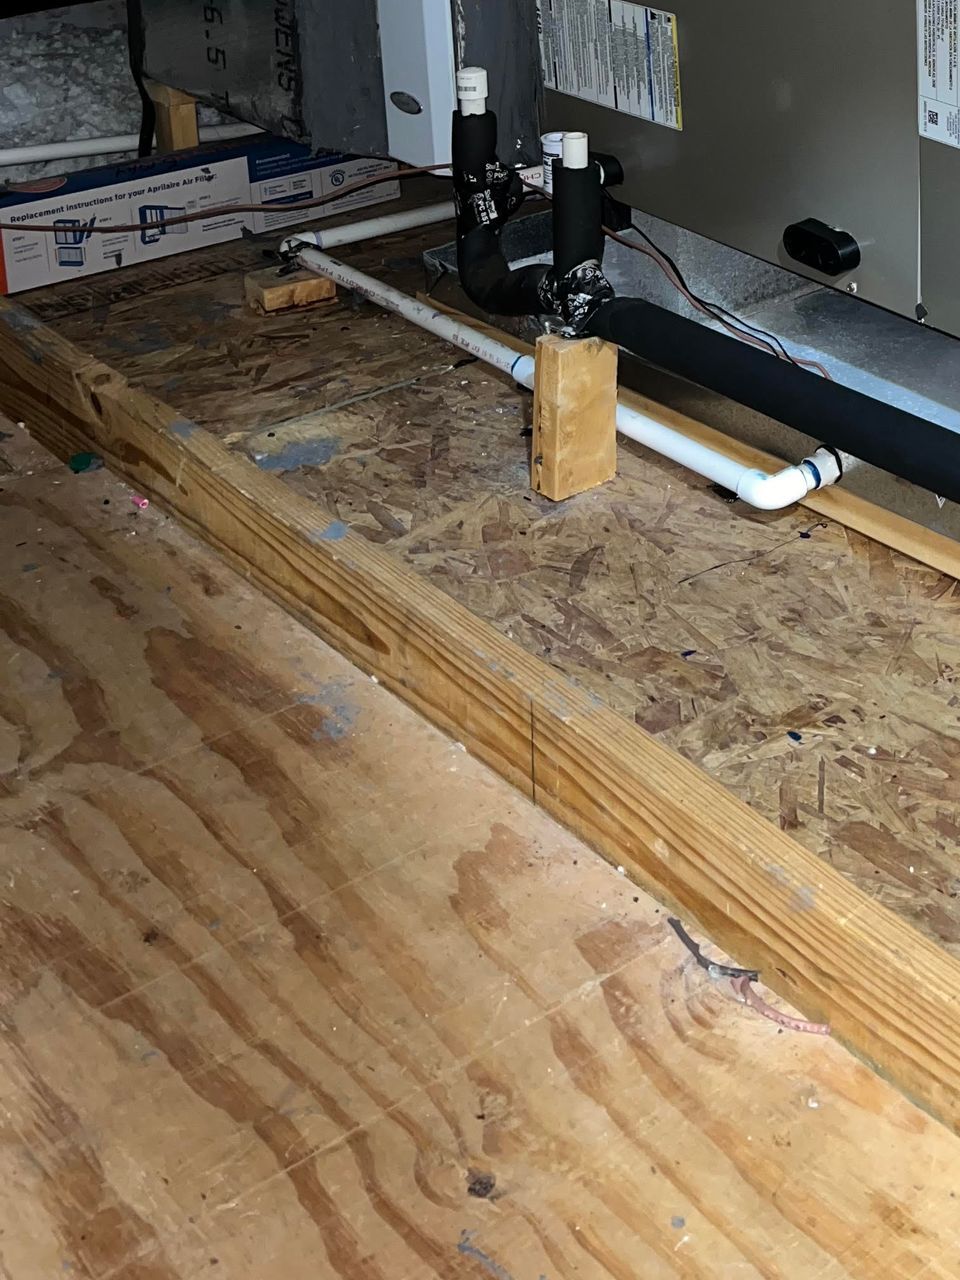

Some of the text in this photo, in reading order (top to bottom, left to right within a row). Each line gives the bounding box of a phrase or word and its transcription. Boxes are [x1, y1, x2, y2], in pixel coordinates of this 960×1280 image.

[10, 206, 65, 224] Replacement
[66, 195, 113, 212] instructions
[115, 191, 126, 201] for
[128, 187, 145, 200] your
[147, 181, 181, 196] Aprilaire
[182, 177, 194, 187] Air
